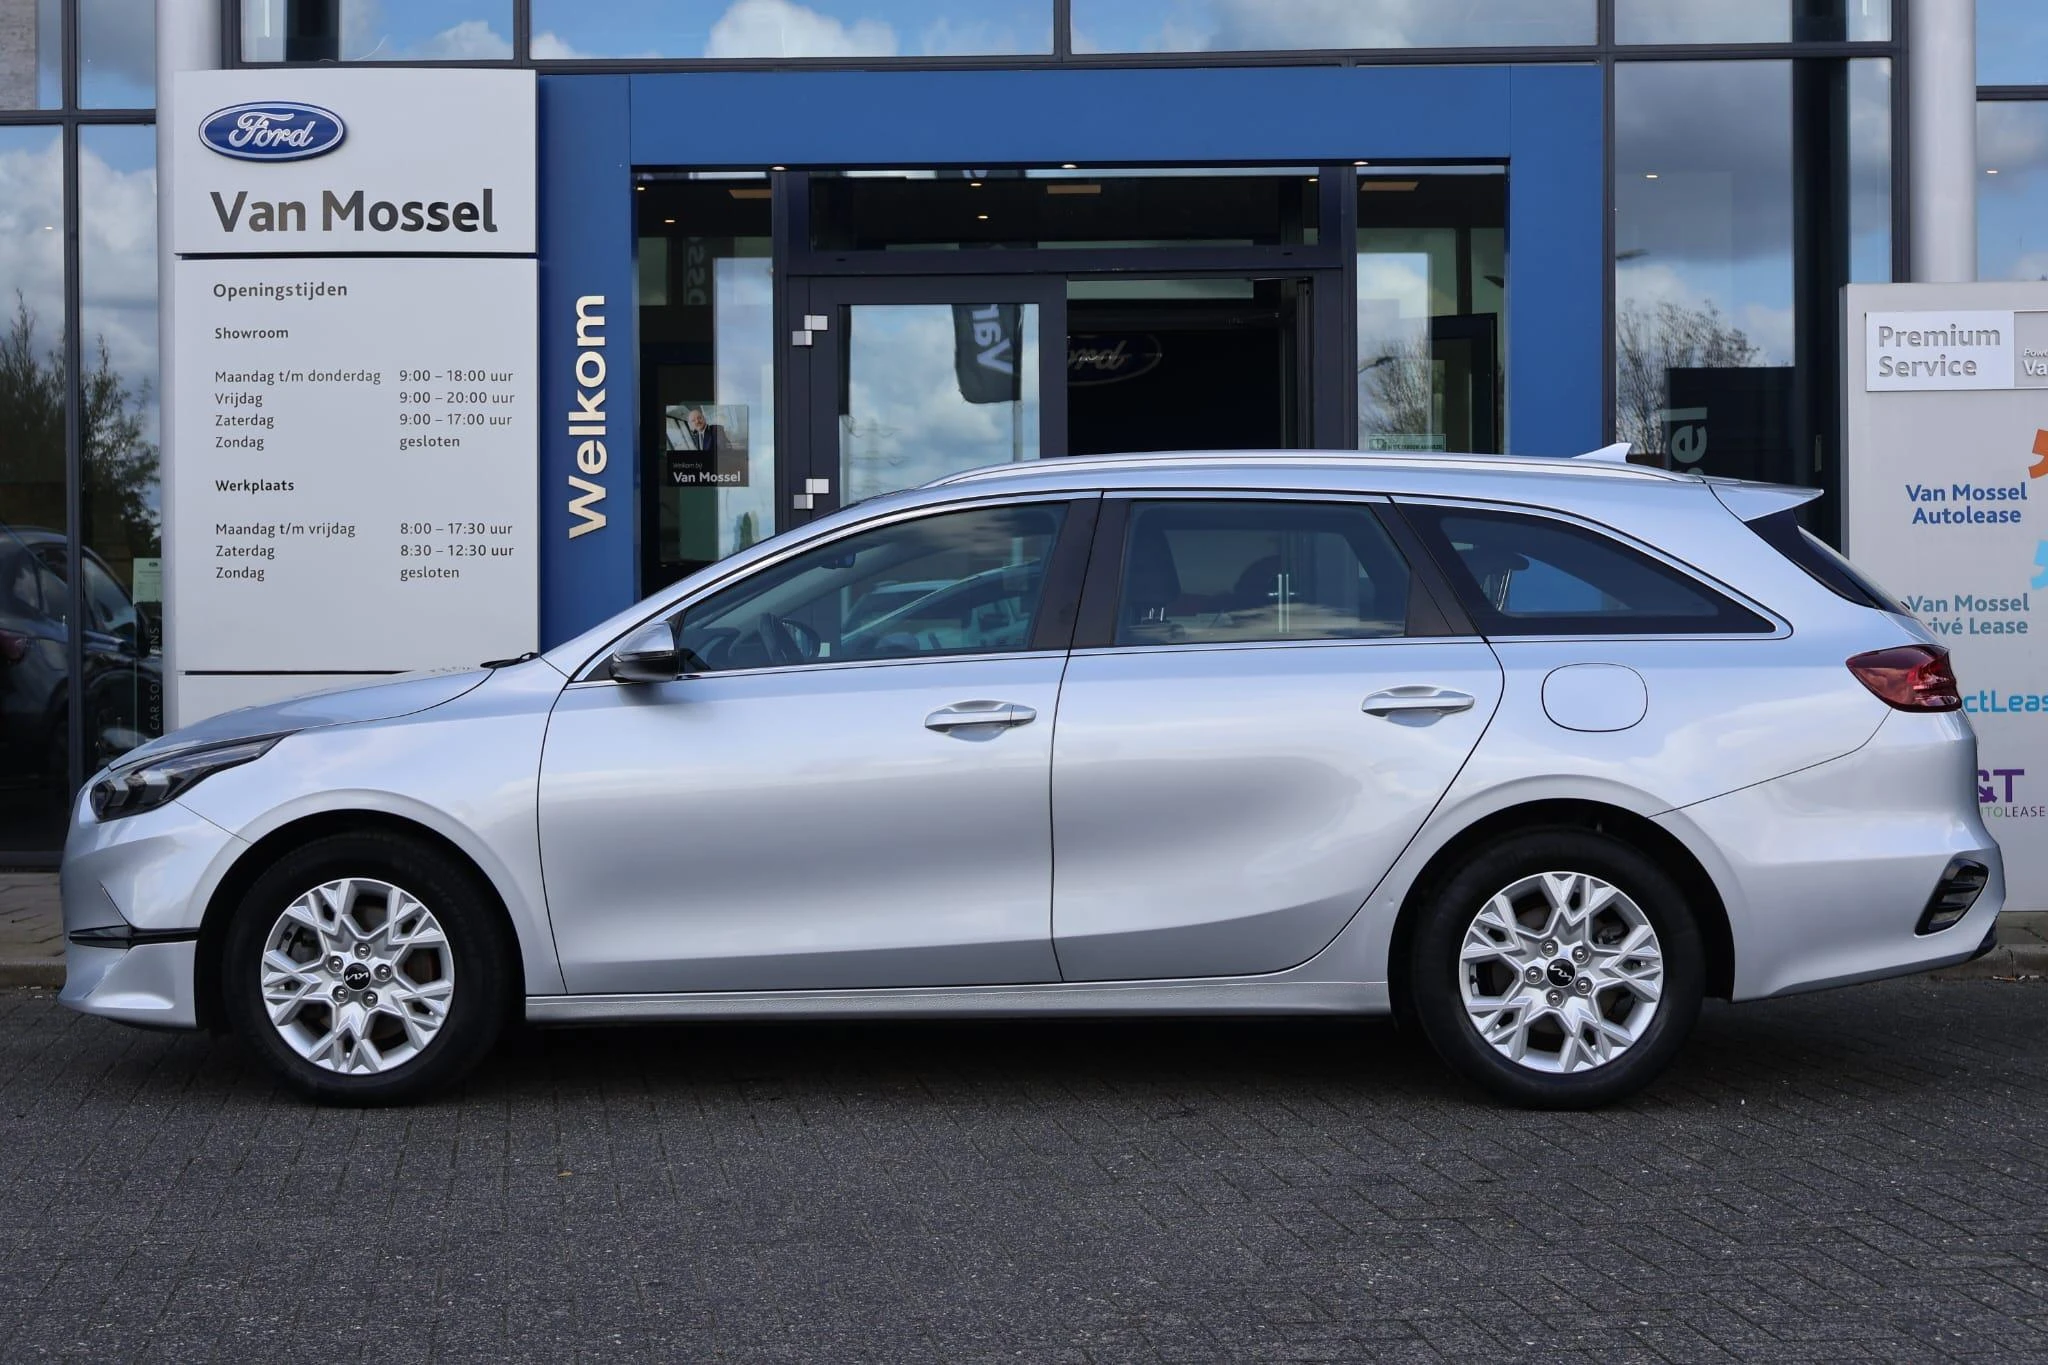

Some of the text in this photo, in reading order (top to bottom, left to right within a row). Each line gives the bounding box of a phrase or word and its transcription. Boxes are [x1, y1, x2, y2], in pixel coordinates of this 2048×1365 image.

[229, 111, 316, 147] Ford
[210, 188, 499, 233] Van Mossel
[213, 281, 348, 300] Openingstijden
[214, 326, 289, 340] Showroom
[1878, 324, 2001, 348] Premium
[1878, 353, 1978, 378] Service
[215, 369, 275, 386] Maandag
[278, 369, 304, 383] t/m
[308, 368, 381, 386] donderdag
[399, 369, 431, 382] 9:00
[447, 369, 486, 382] 18:00
[490, 372, 514, 382] uur
[215, 391, 263, 408] Vrijdag
[399, 391, 431, 404] 9:00
[447, 391, 488, 404] 20:00
[491, 393, 515, 404] uur
[215, 412, 275, 430] Zaterdag
[399, 412, 431, 426] 9:00
[447, 412, 485, 426] 17:00
[489, 416, 513, 426] uur
[568, 295, 608, 539] Welkom
[215, 434, 460, 451] Zondag gesloten
[1656, 407, 1707, 475] el
[673, 470, 741, 483] Van Mossel
[215, 478, 295, 496] Werkplaats
[1905, 481, 2028, 503] Van Mossel
[1911, 504, 2022, 525] Autolease
[215, 521, 276, 539] Maandag
[279, 522, 305, 536] t/m
[308, 521, 356, 539] vrijdag
[400, 522, 432, 535] 8:00
[447, 522, 486, 535] 17:30
[489, 524, 513, 535] uur
[215, 543, 276, 561] Zaterdag
[400, 544, 432, 557] 8:30
[447, 544, 487, 557] 12:30
[491, 546, 515, 557] uur
[215, 565, 460, 583] Zondag gesloten
[1907, 592, 2030, 613] Van Mossel
[1926, 617, 2028, 635] ivé Lease
[1980, 805, 2046, 818] TOLEASE
